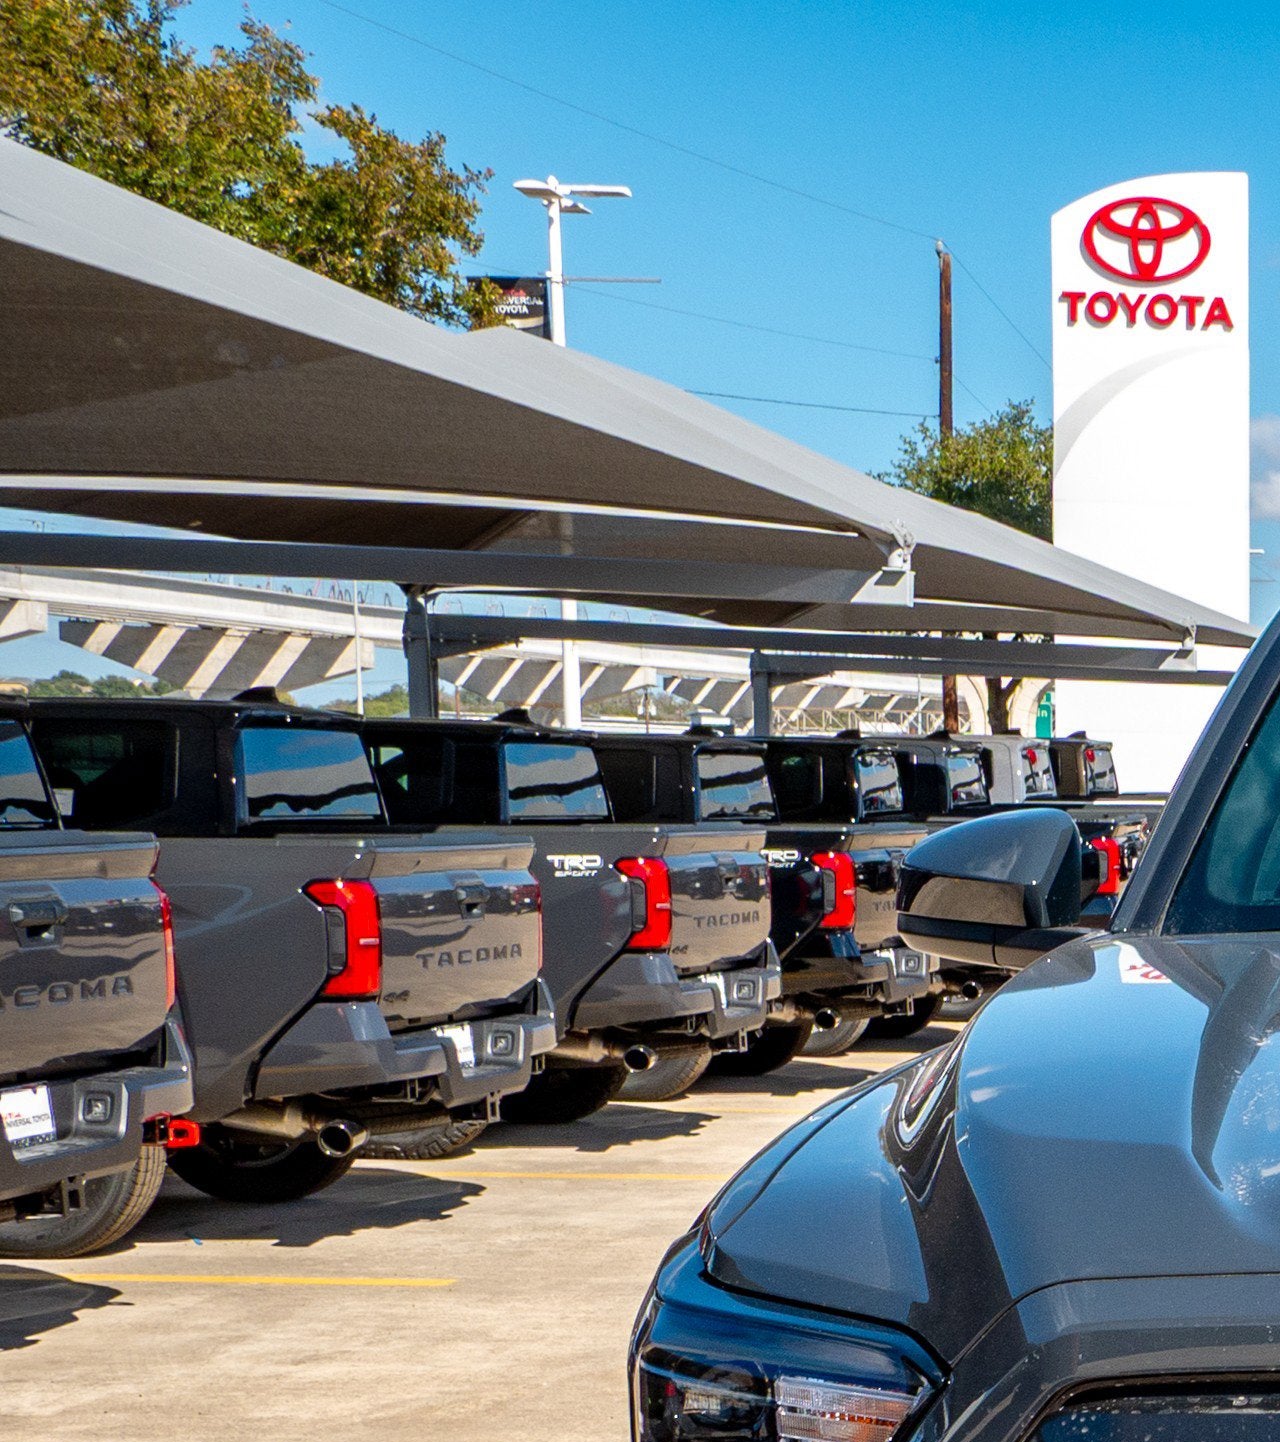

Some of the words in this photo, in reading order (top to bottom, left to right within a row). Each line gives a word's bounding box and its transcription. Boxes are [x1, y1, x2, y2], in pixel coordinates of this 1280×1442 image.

[1059, 290, 1234, 332] TOYOTA
[546, 854, 604, 870] TRD
[760, 849, 801, 863] TRD
[693, 909, 760, 928] TACOMA
[416, 943, 522, 969] TACOMA
[0, 975, 134, 1012] COMA
